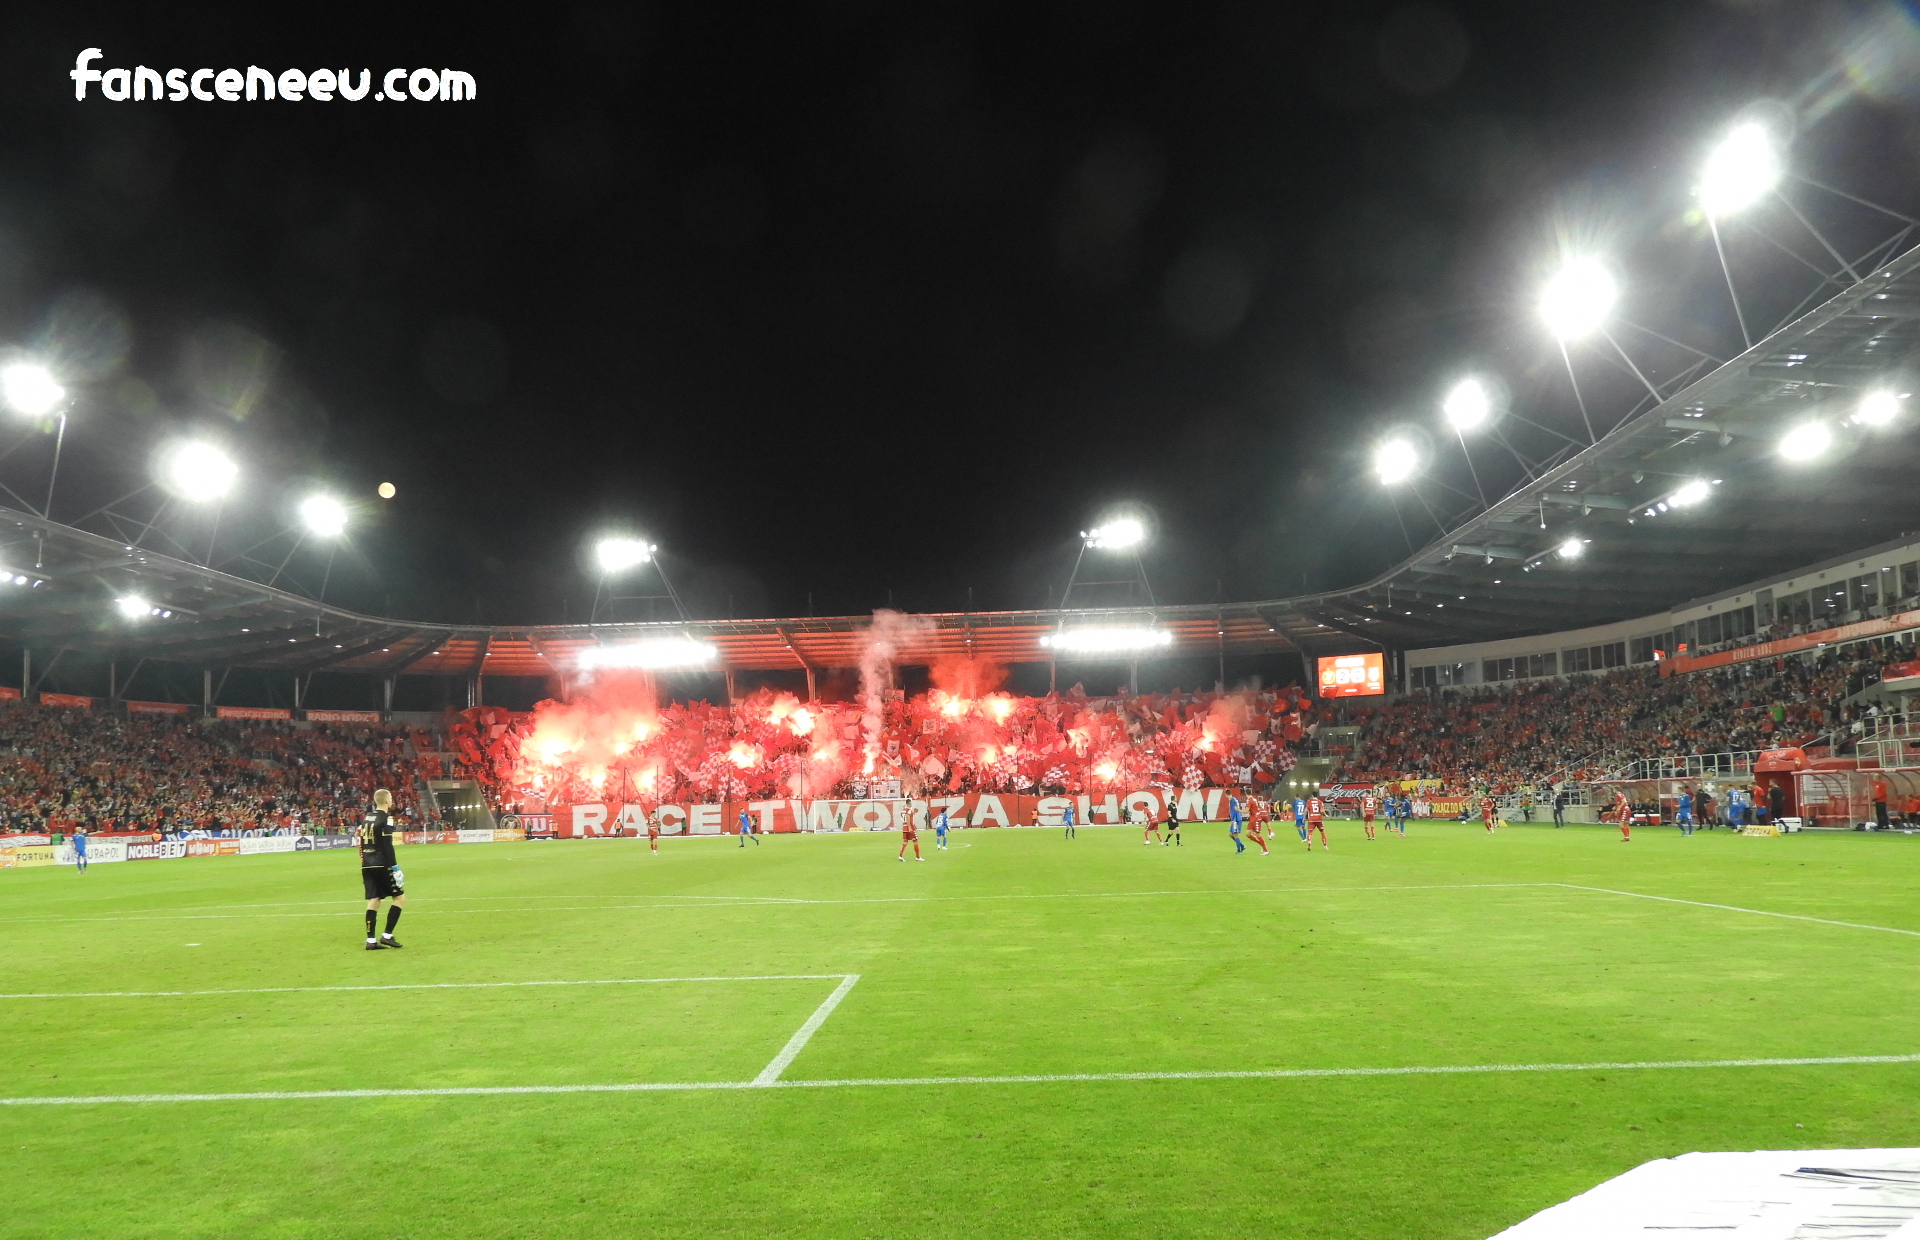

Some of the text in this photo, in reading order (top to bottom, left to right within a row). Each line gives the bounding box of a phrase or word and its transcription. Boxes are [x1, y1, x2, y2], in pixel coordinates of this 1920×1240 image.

[307, 712, 340, 721] RADIO
[572, 804, 722, 836] RACE
[1037, 789, 1224, 826] SHOW
[1311, 803, 1320, 813] 15
[16, 852, 55, 862] FORTUNA
[86, 847, 119, 860] URAPOL
